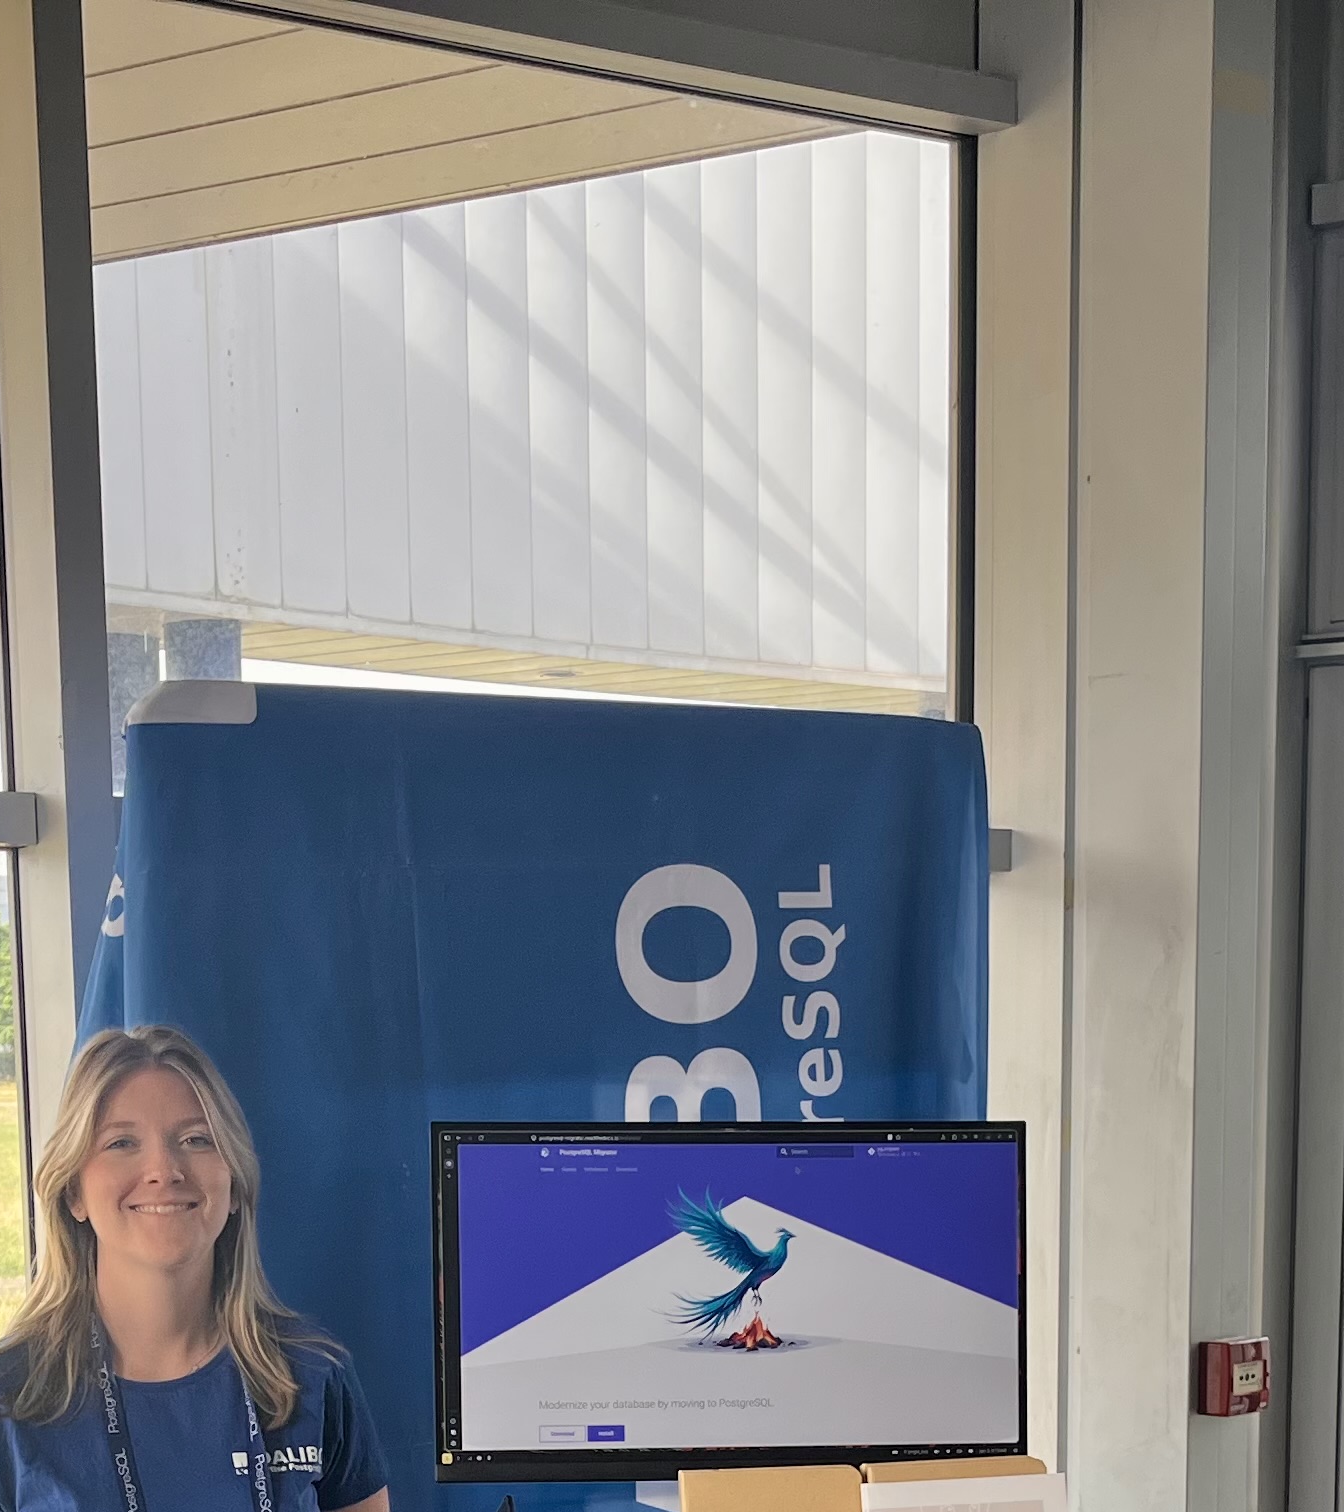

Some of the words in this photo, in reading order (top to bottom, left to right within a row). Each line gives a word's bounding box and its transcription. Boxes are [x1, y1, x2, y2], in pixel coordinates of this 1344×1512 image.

[97, 1360, 120, 1434] PostgreSQL
[538, 1400, 588, 1409] Modernize
[590, 1401, 610, 1411] your
[612, 1399, 655, 1409] database
[657, 1399, 668, 1411] by
[670, 1399, 705, 1410] moving
[707, 1399, 717, 1408] to
[265, 1445, 322, 1465] ALIB
